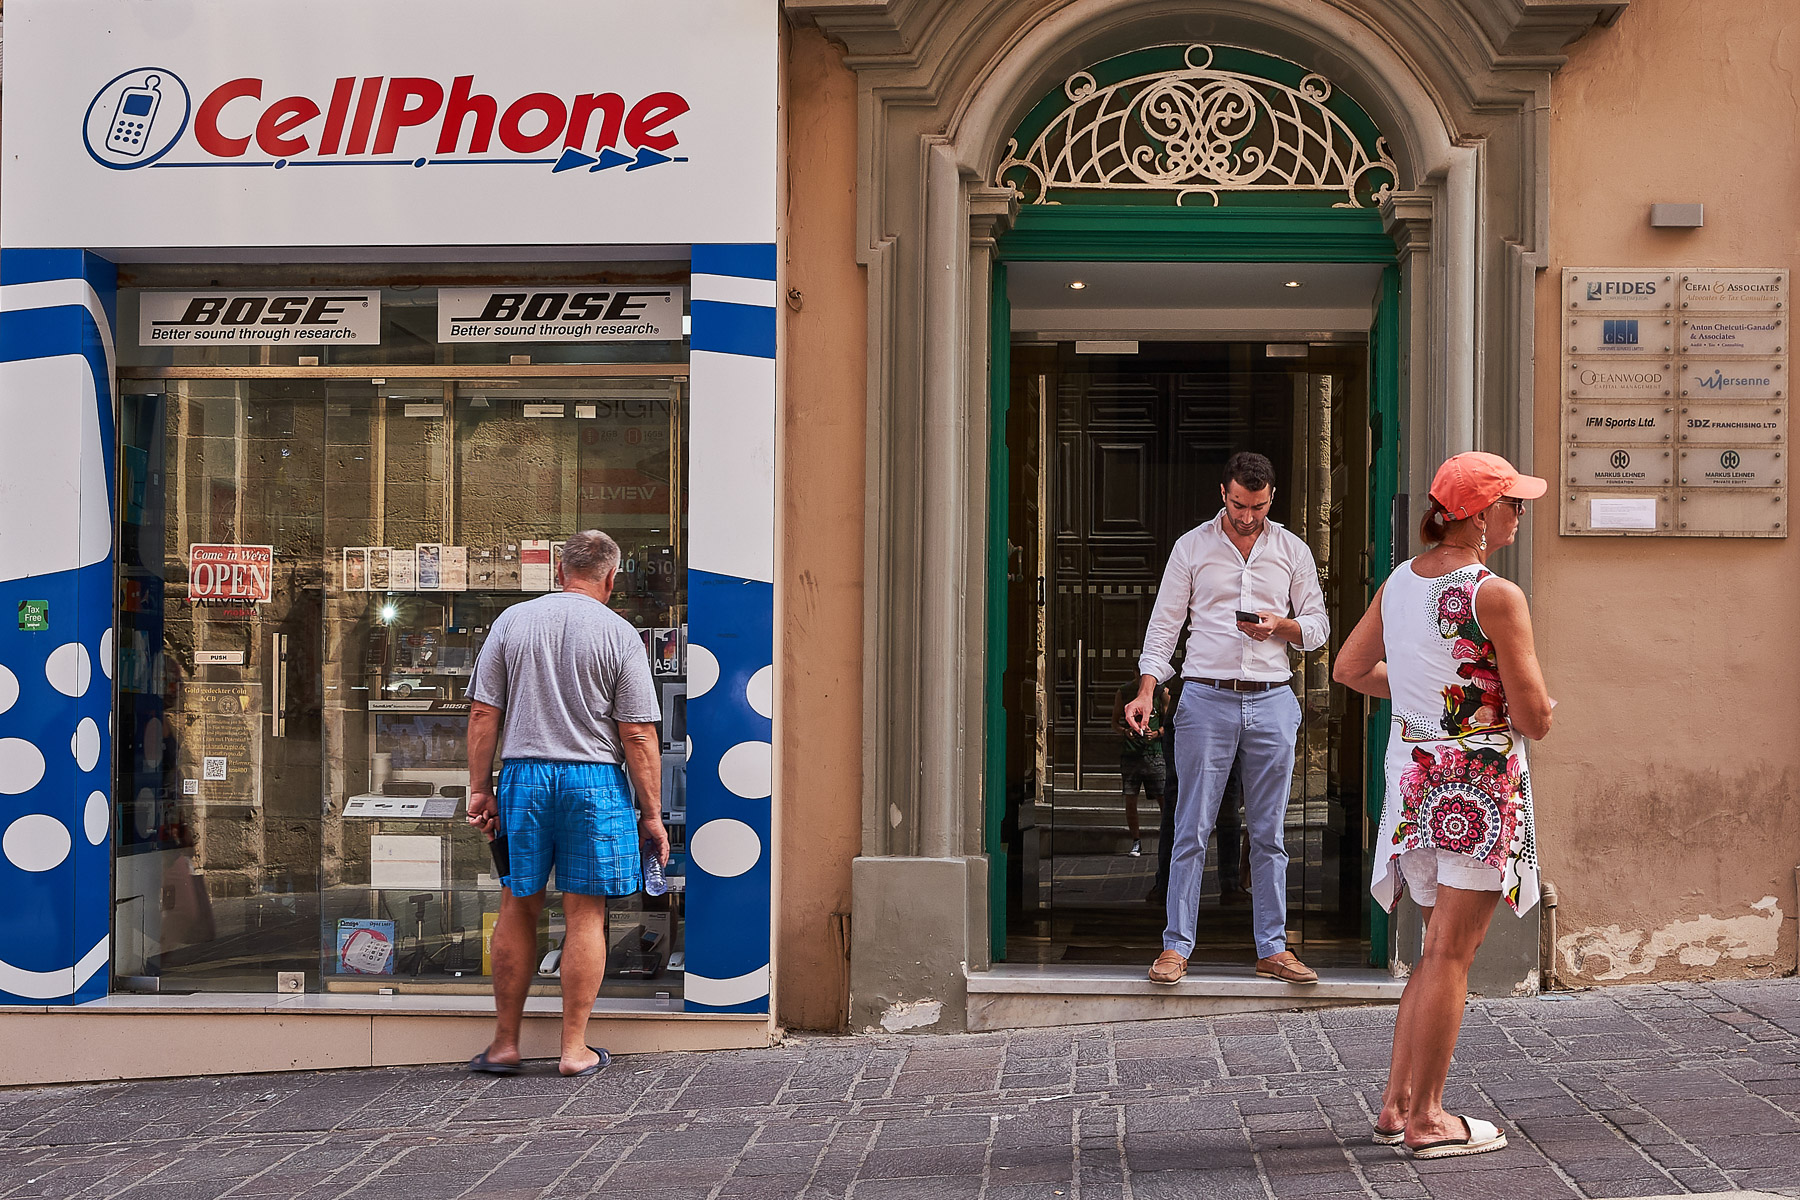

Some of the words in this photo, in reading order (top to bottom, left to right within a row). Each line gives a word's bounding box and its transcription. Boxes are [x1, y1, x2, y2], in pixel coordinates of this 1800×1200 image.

[194, 74, 691, 158] CellPhone
[1605, 281, 1656, 295] FIDES
[1727, 283, 1780, 292] ASSOCIATES
[151, 328, 192, 340] Better
[194, 327, 236, 340] sound
[239, 327, 290, 341] through
[451, 325, 492, 337] Better
[494, 324, 536, 336] sound
[540, 323, 592, 337] through
[1580, 369, 1663, 386] OCEANWOOD
[1585, 417, 1604, 427] IFM
[1604, 417, 1637, 430] Sports
[1638, 417, 1656, 427] Ltd.
[1687, 419, 1711, 428] 3DZ
[194, 549, 223, 560] Come
[227, 550, 238, 560] in
[241, 550, 270, 562] We're
[193, 562, 269, 597] OPEN
[27, 605, 40, 613] Tax
[25, 613, 42, 621] Free
